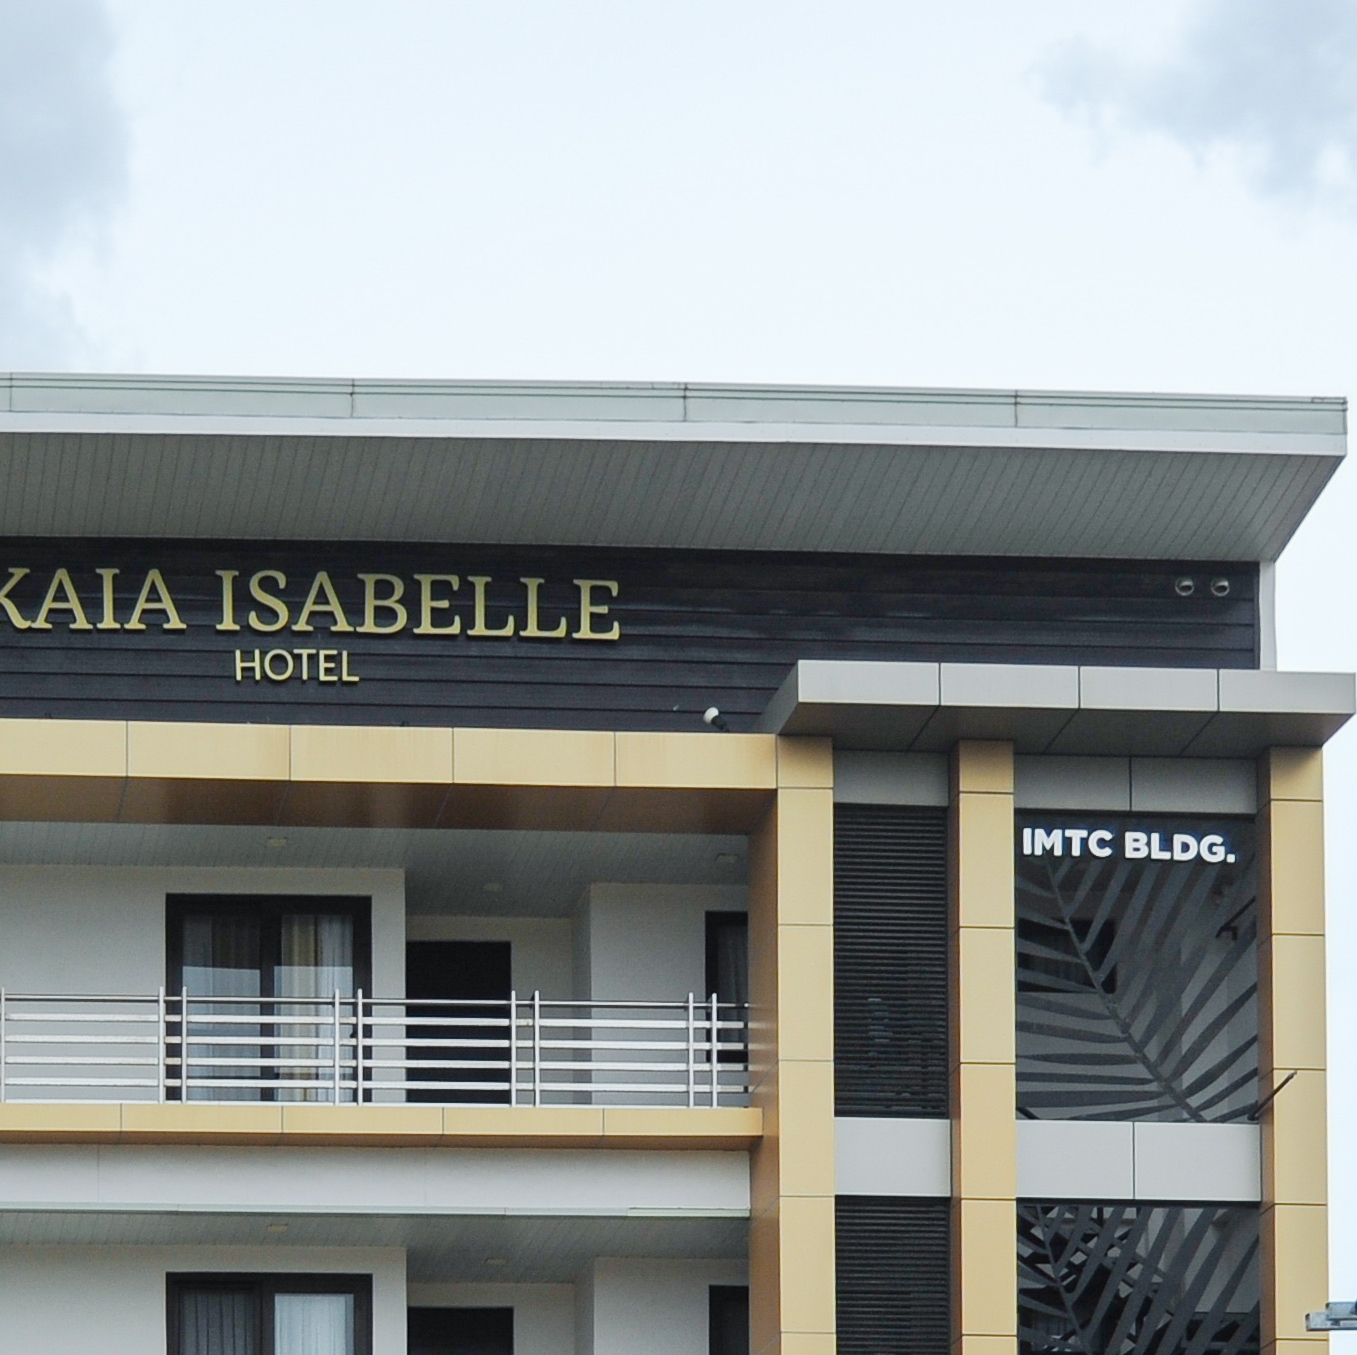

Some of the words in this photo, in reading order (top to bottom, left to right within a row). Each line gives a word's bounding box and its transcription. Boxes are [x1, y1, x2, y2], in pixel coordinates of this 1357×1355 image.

[215, 569, 621, 640] ISABELLE
[235, 648, 360, 682] HOTEL
[1023, 827, 1114, 858] IMTC
[1124, 831, 1236, 863] BLDG.
